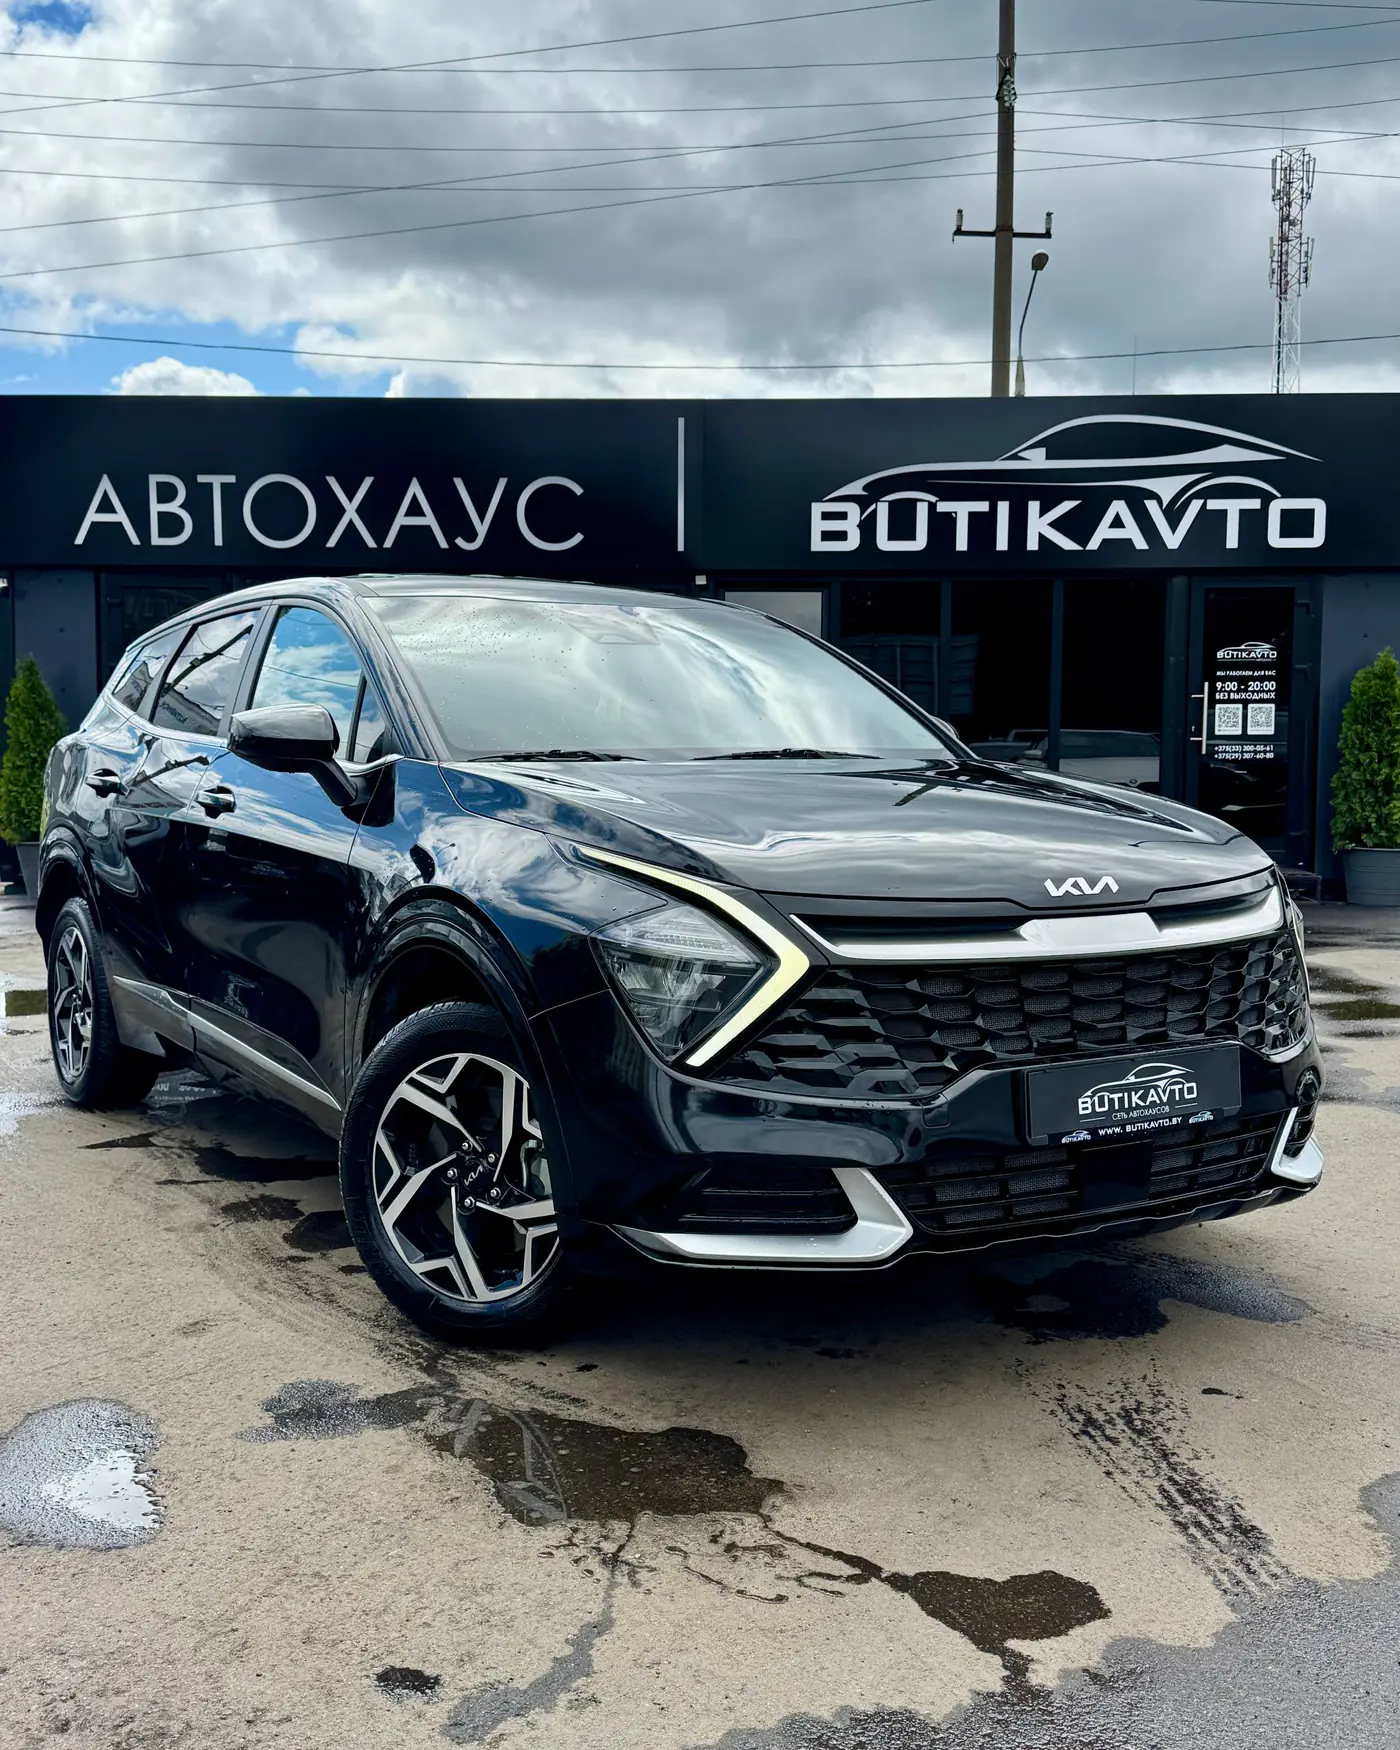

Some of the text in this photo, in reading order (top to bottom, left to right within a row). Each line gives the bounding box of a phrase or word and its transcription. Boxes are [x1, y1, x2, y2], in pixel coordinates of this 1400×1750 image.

[74, 473, 585, 552] АВТОХАУС
[811, 498, 1326, 552] BUTIKAVTO
[1217, 650, 1277, 659] BUTIKAVTO
[1216, 681, 1238, 691] 9:00
[1247, 681, 1276, 691] 20:00
[1215, 692, 1276, 700] БЕЗ ВЫХОДНЫХ
[1044, 875, 1120, 897] KIA
[1078, 1082, 1198, 1115] BUTIKAVTO
[1111, 1105, 1170, 1121] СЕТЬ АВТОХАУСОВ
[1125, 1116, 1183, 1133] BUTIKAVTO.BY
